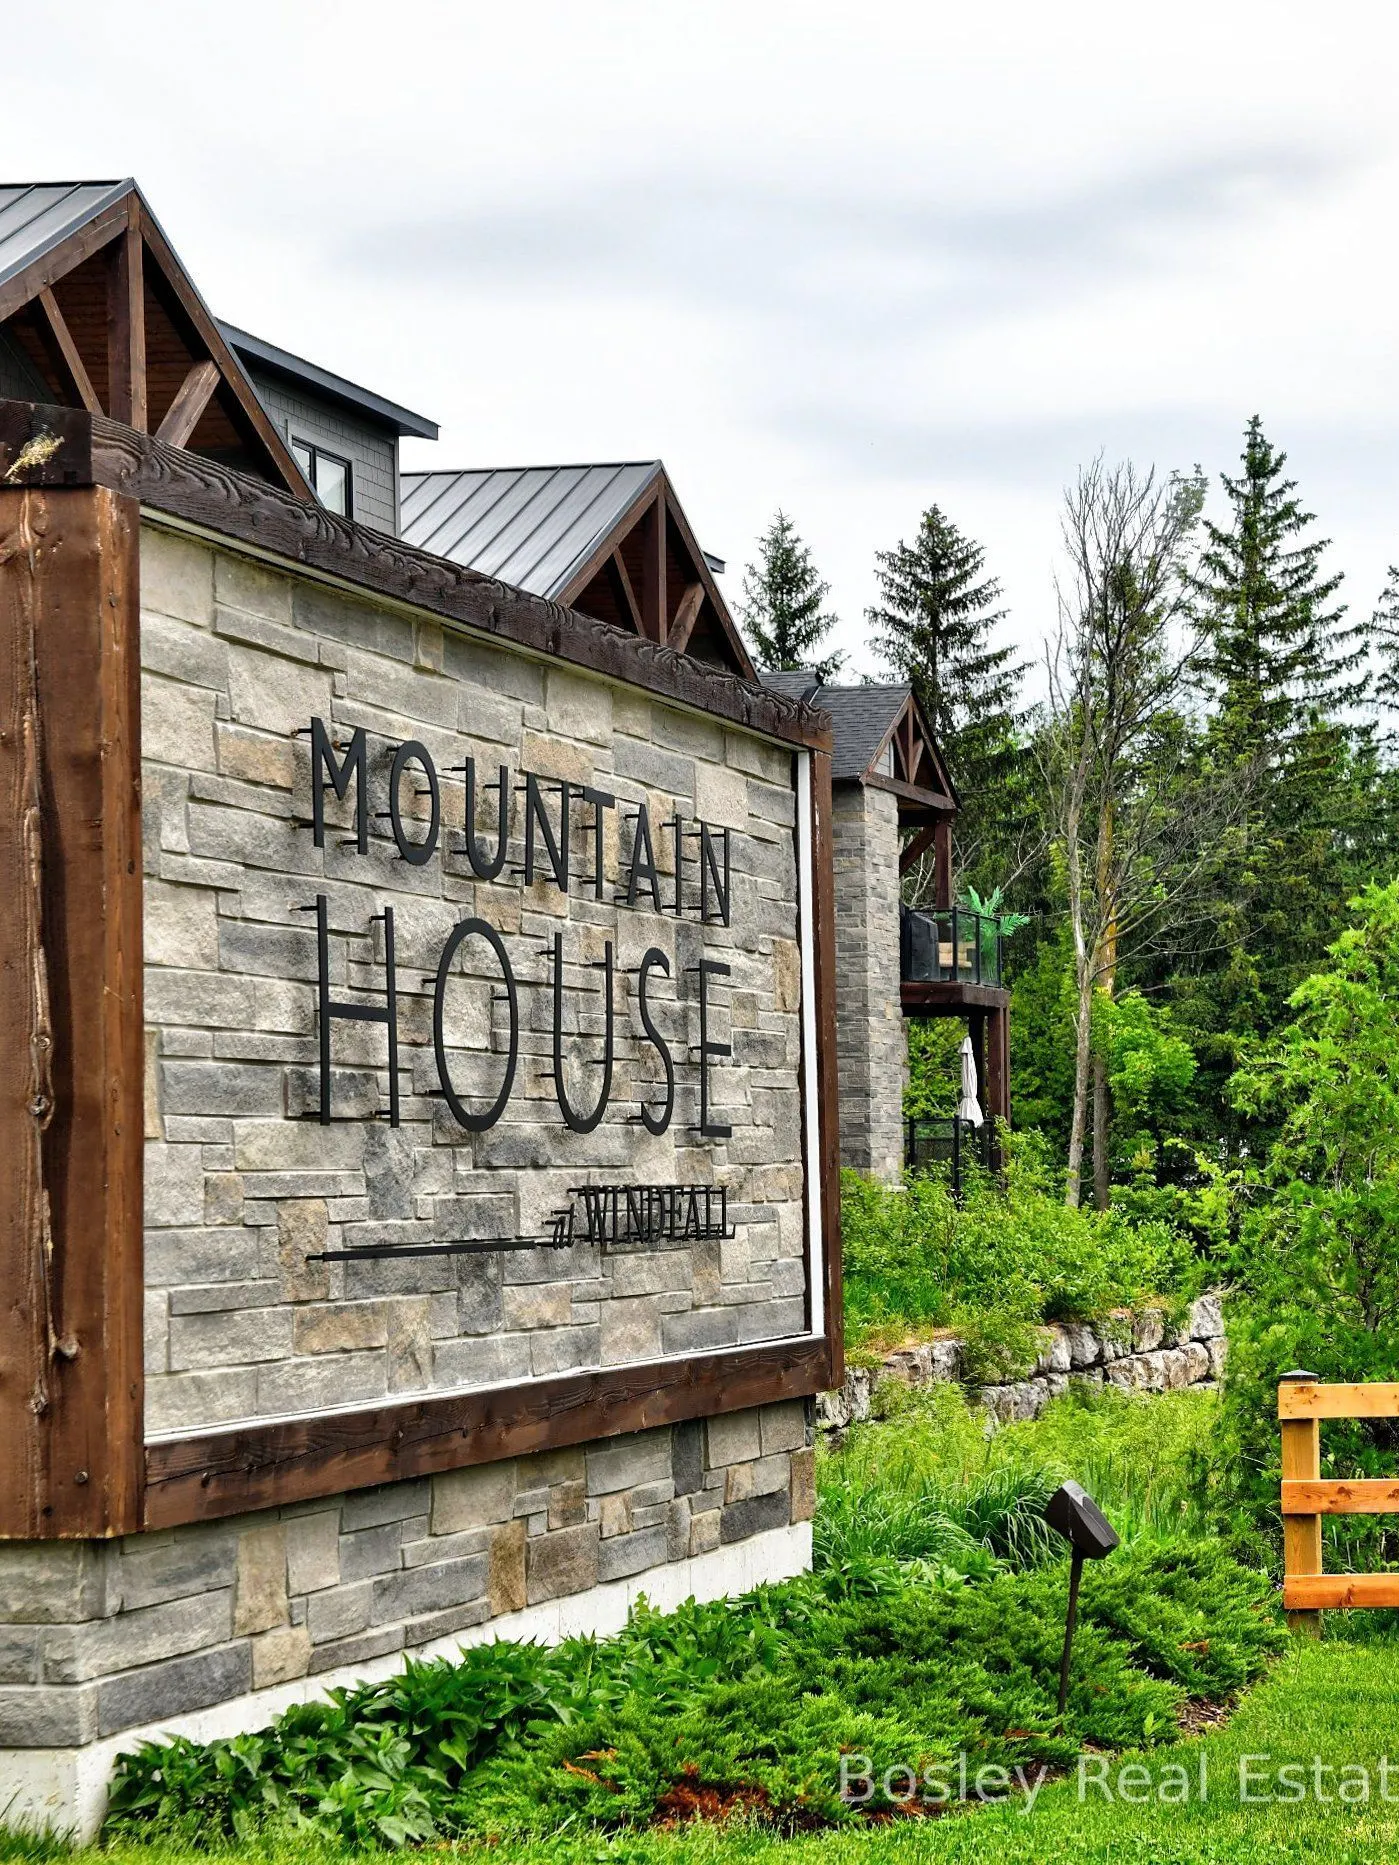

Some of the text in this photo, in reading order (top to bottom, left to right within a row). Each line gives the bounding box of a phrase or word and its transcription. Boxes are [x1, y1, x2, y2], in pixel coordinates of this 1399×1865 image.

[311, 717, 730, 927] MOUNTAIN
[316, 895, 732, 1137] HOUSE
[582, 1184, 736, 1247] WINDFALL
